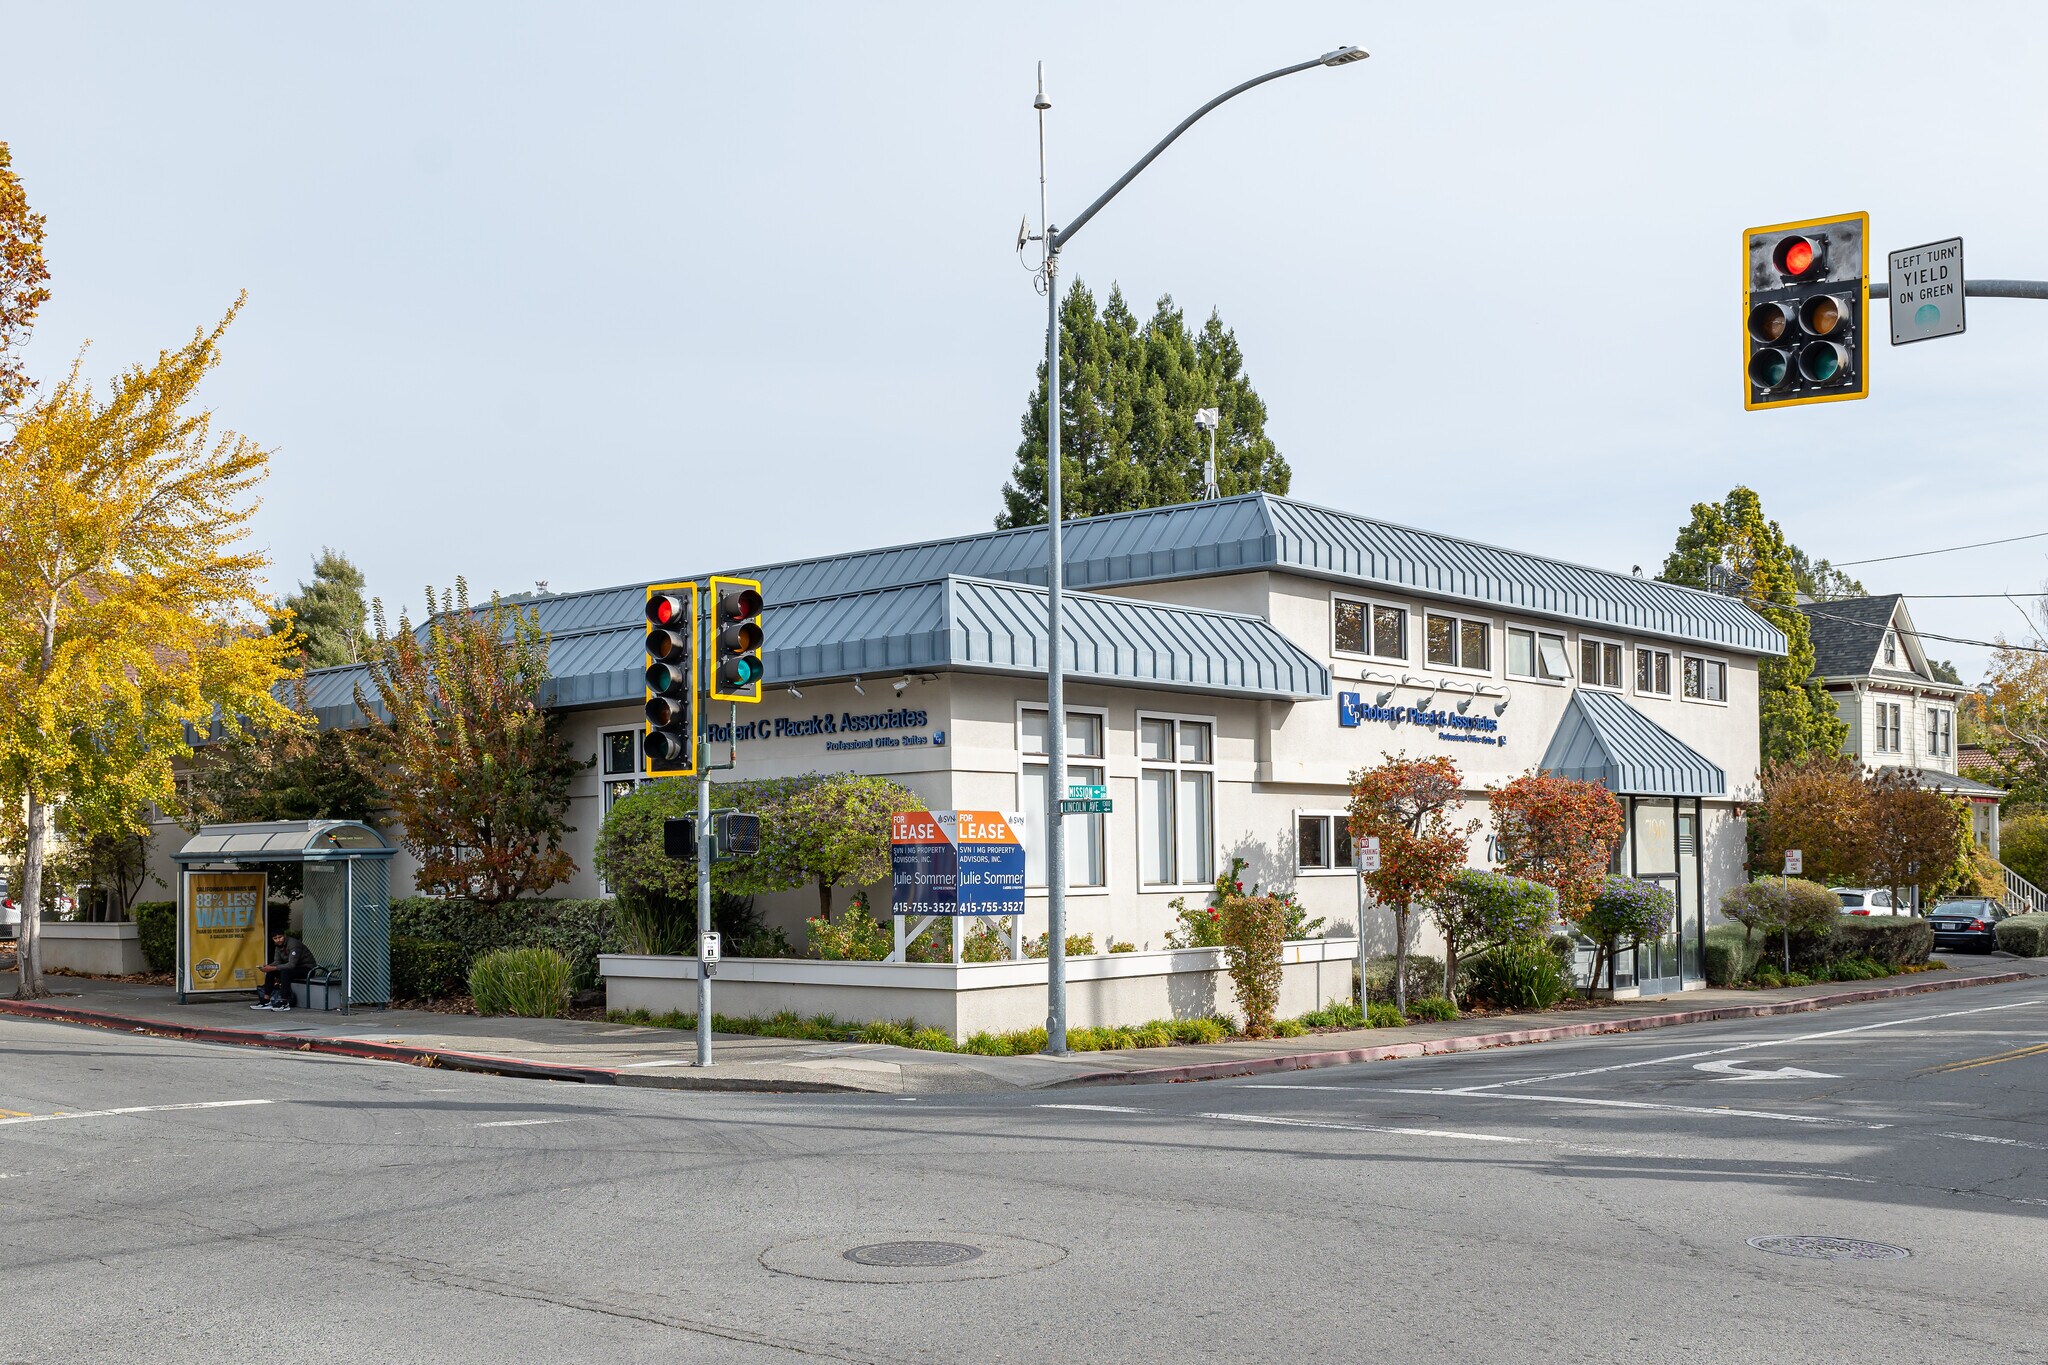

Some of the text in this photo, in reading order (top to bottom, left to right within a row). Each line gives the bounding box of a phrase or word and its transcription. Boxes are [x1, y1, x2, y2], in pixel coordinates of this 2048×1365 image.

[1897, 246, 1954, 270] LEFT TURN
[1904, 265, 1948, 287] YIELD
[1900, 283, 1954, 304] ON GREEN
[757, 719, 771, 739] C
[774, 715, 823, 737] Placak
[823, 713, 837, 733] &
[839, 708, 928, 731] Associates
[1361, 702, 1396, 721] Robert
[1396, 706, 1406, 723] C
[1448, 711, 1498, 731] Associates
[826, 734, 928, 751] Professional Office Suites
[1069, 786, 1093, 797] MISSION
[1064, 801, 1087, 812] LINCOLN
[893, 815, 905, 824] FOR
[943, 815, 956, 823] SVN
[959, 813, 973, 822] FOR
[1013, 816, 1024, 824] SVN
[893, 823, 935, 840] LEASE
[959, 823, 1005, 839] LEASE
[917, 846, 946, 854] PROPERTY
[987, 846, 1015, 854] PROPERTY
[959, 855, 1002, 863] ADVISORS, INC.
[893, 871, 956, 887] Julie Sommer
[959, 871, 1024, 887] Julie Sommer
[196, 892, 257, 907] 88% LESS
[959, 901, 1024, 913] 415-755-3527
[893, 902, 956, 913] 415-755-3527
[196, 906, 256, 928] WATER
